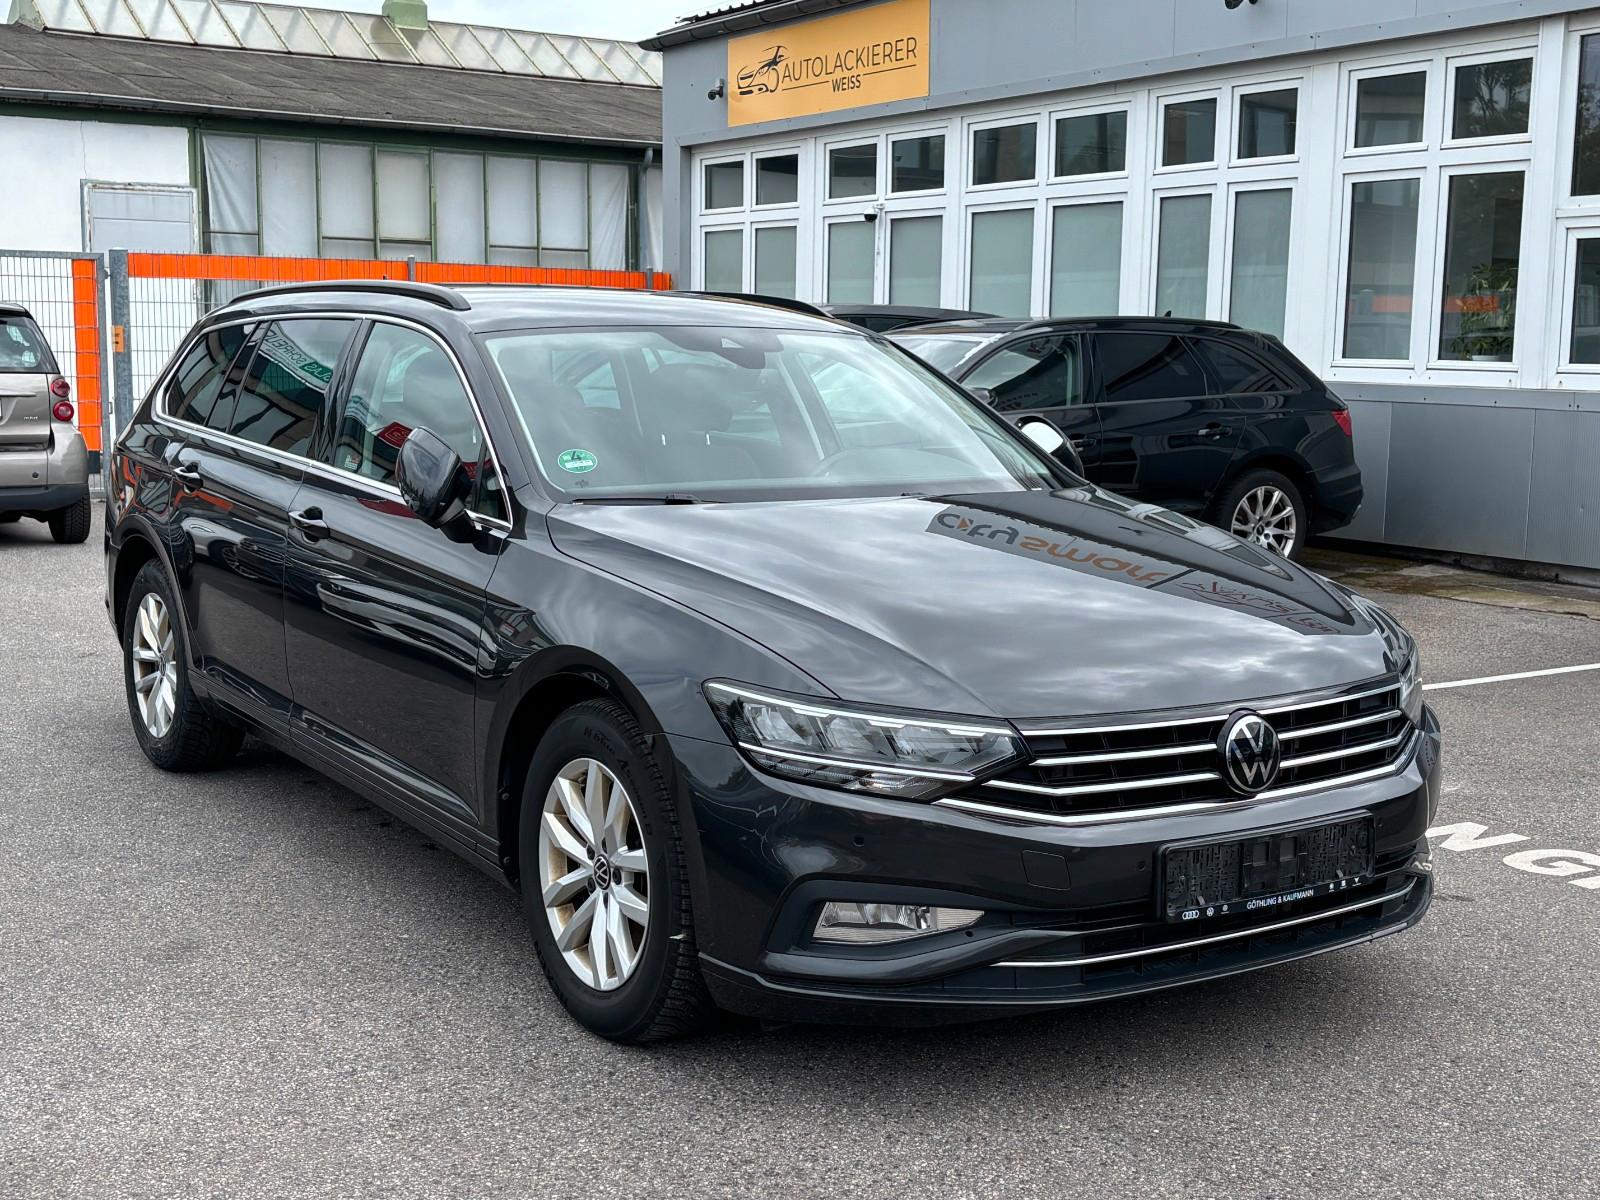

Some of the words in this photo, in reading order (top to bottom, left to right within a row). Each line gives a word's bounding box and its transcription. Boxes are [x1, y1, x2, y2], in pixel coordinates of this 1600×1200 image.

[781, 37, 917, 83] AUTOLACKIERER
[832, 74, 861, 92] WEISS
[1247, 897, 1277, 910] GÖTHLING
[1277, 894, 1282, 903] &
[1282, 889, 1314, 902] KAUFMANN
